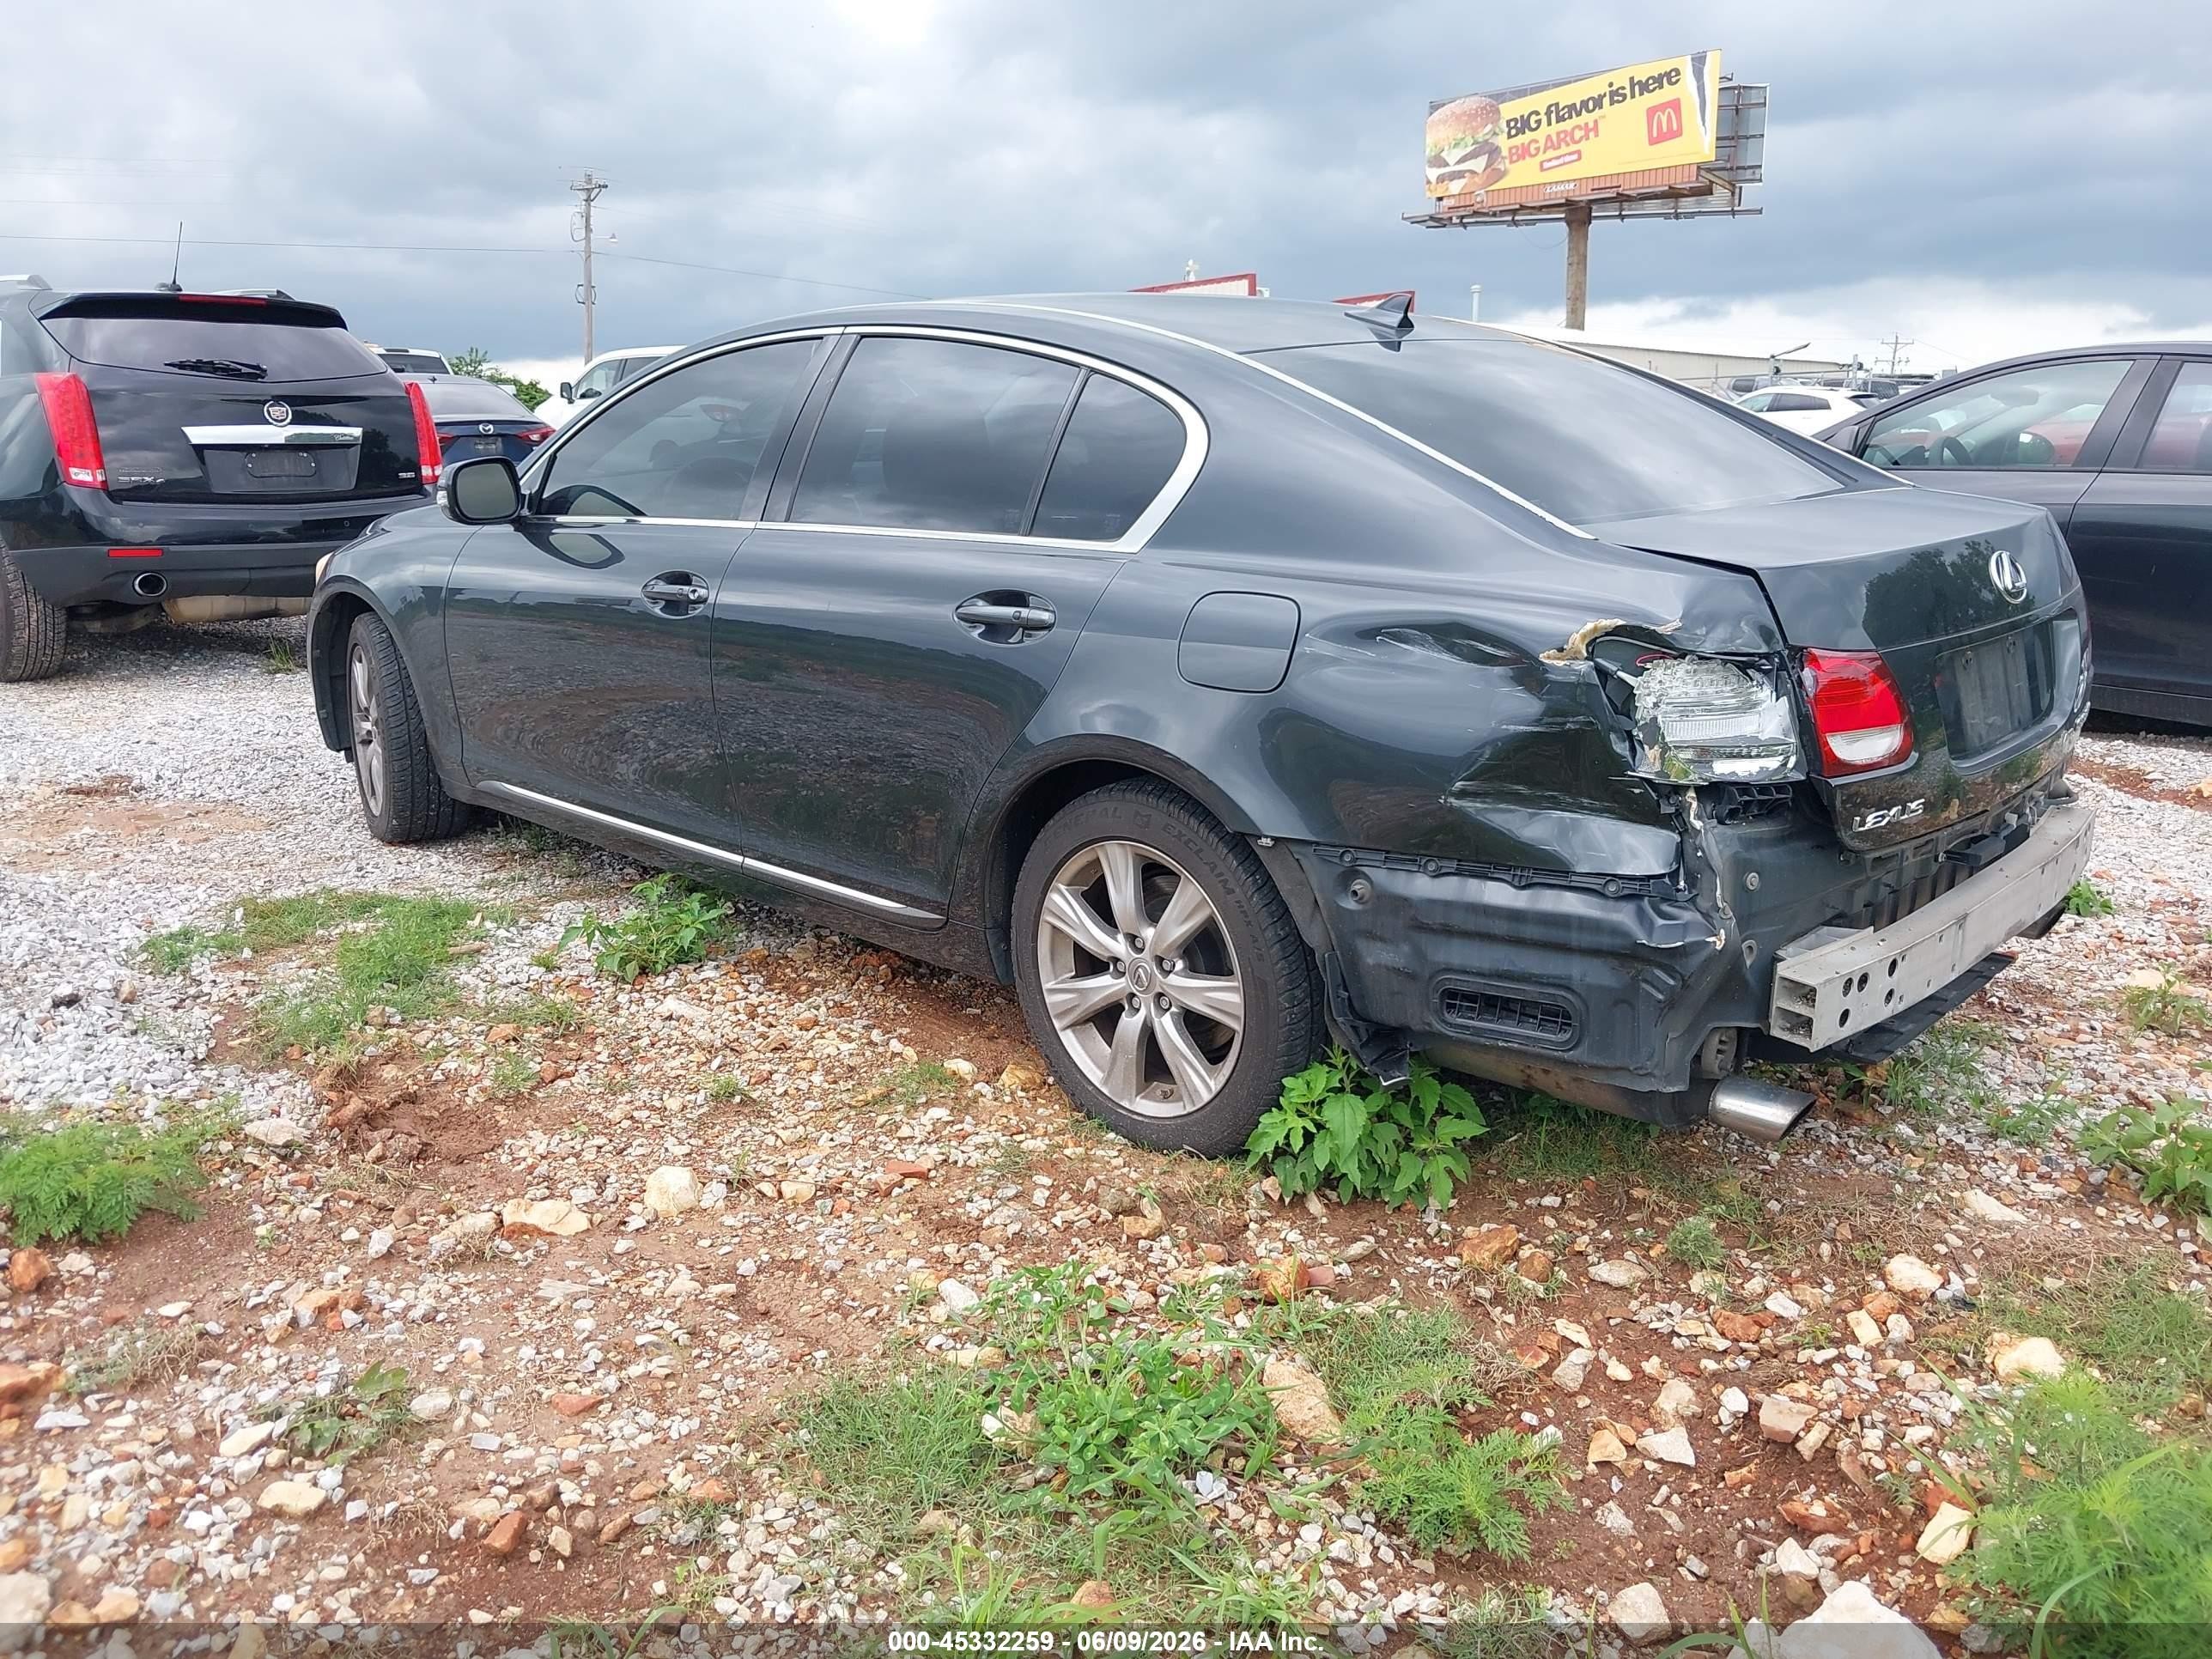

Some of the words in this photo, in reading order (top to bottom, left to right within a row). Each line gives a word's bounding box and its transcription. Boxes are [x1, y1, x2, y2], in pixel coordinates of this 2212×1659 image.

[1506, 110, 1542, 140] BIG
[1545, 91, 1607, 127] flavor
[1607, 82, 1628, 106] is
[1629, 67, 1681, 100] here
[1508, 139, 1540, 165] BIG
[1543, 119, 1600, 154] ARCH
[1852, 798, 1925, 832] LEXUS
[1162, 823, 1236, 896] EXCLAIM
